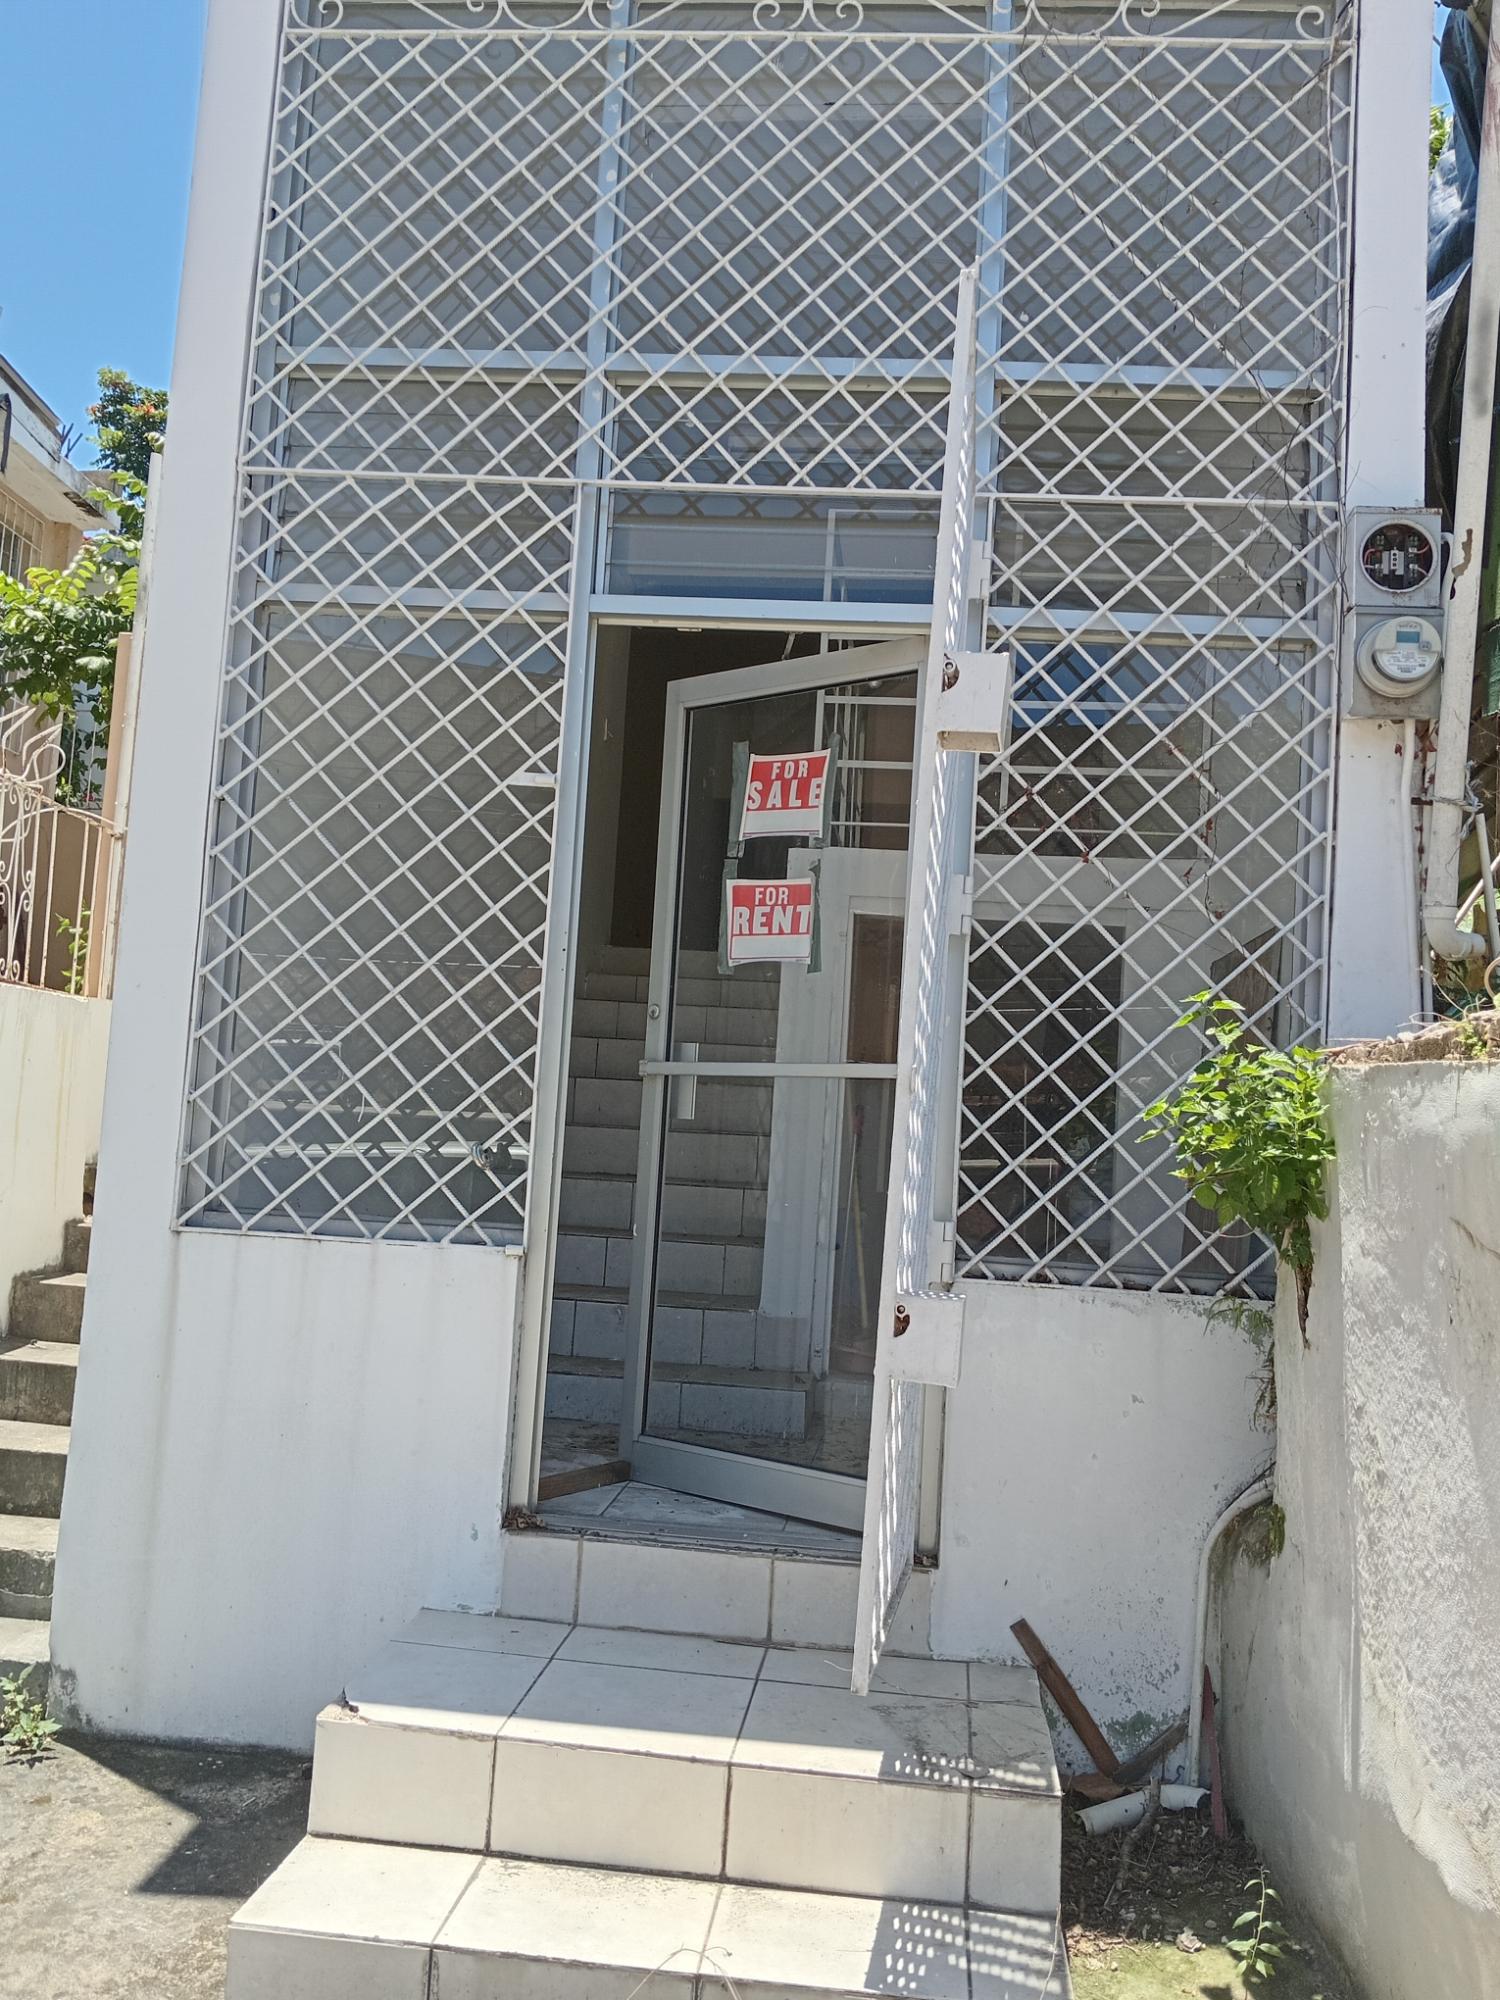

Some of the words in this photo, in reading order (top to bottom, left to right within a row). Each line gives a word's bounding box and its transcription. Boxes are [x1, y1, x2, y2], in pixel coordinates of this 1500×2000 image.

[771, 760, 809, 779] FOR
[747, 778, 823, 810] SALE
[754, 887, 789, 905] FOR
[733, 905, 811, 934] RENT
